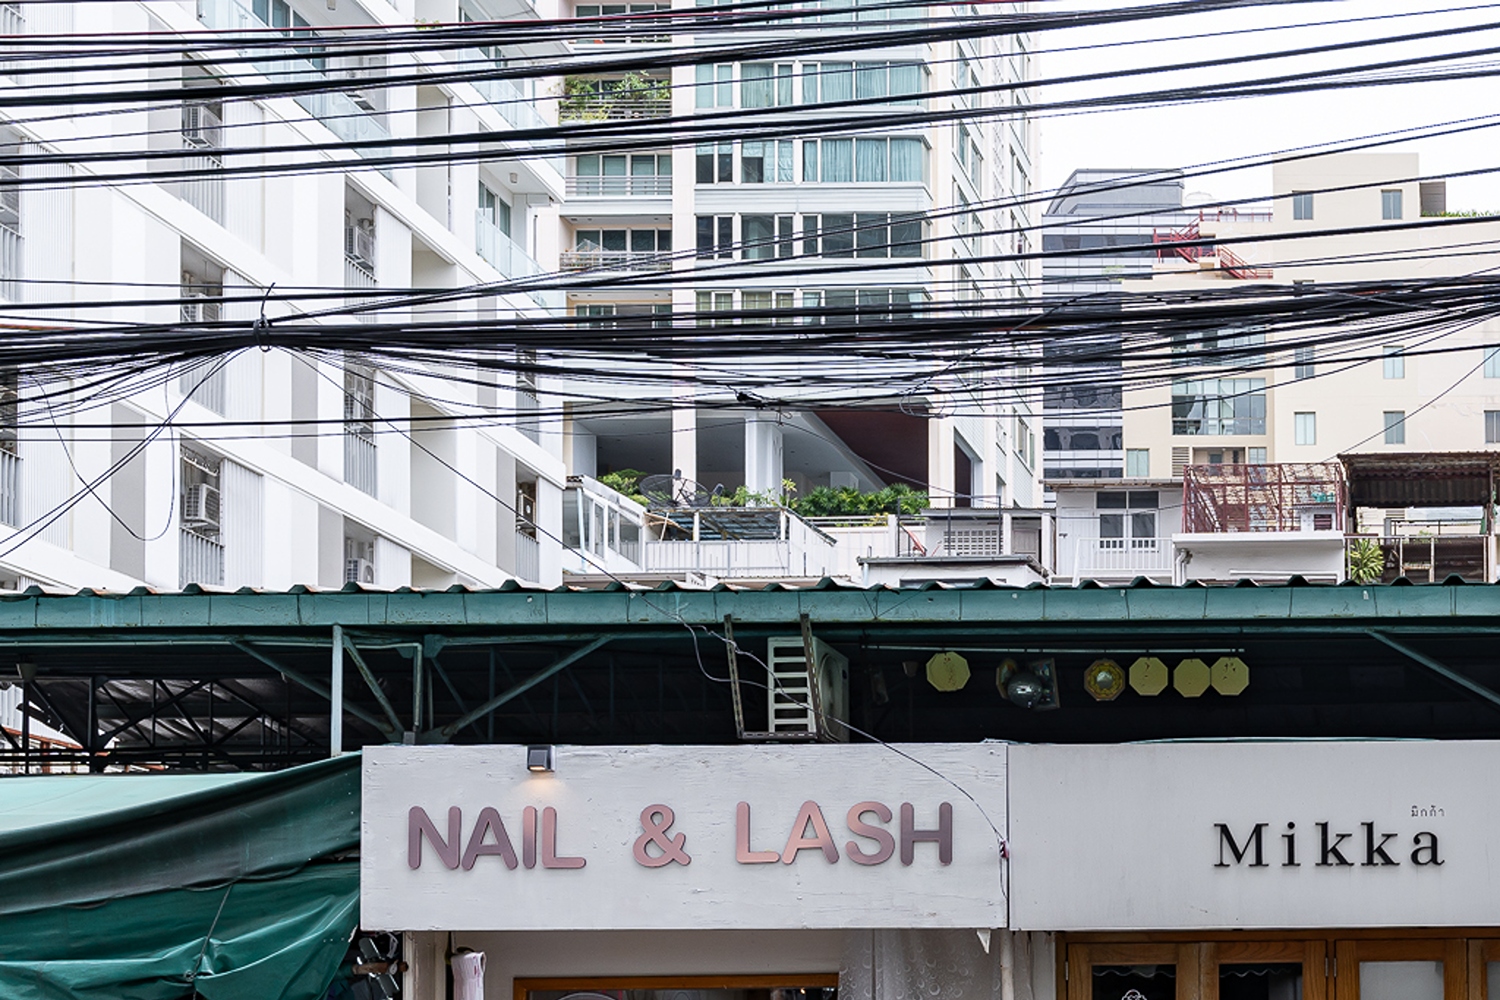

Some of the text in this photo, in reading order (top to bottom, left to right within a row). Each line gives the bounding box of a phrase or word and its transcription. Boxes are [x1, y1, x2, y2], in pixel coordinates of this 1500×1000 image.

[408, 800, 953, 870] NAIL & LASH
[1213, 821, 1445, 867] Mikka
